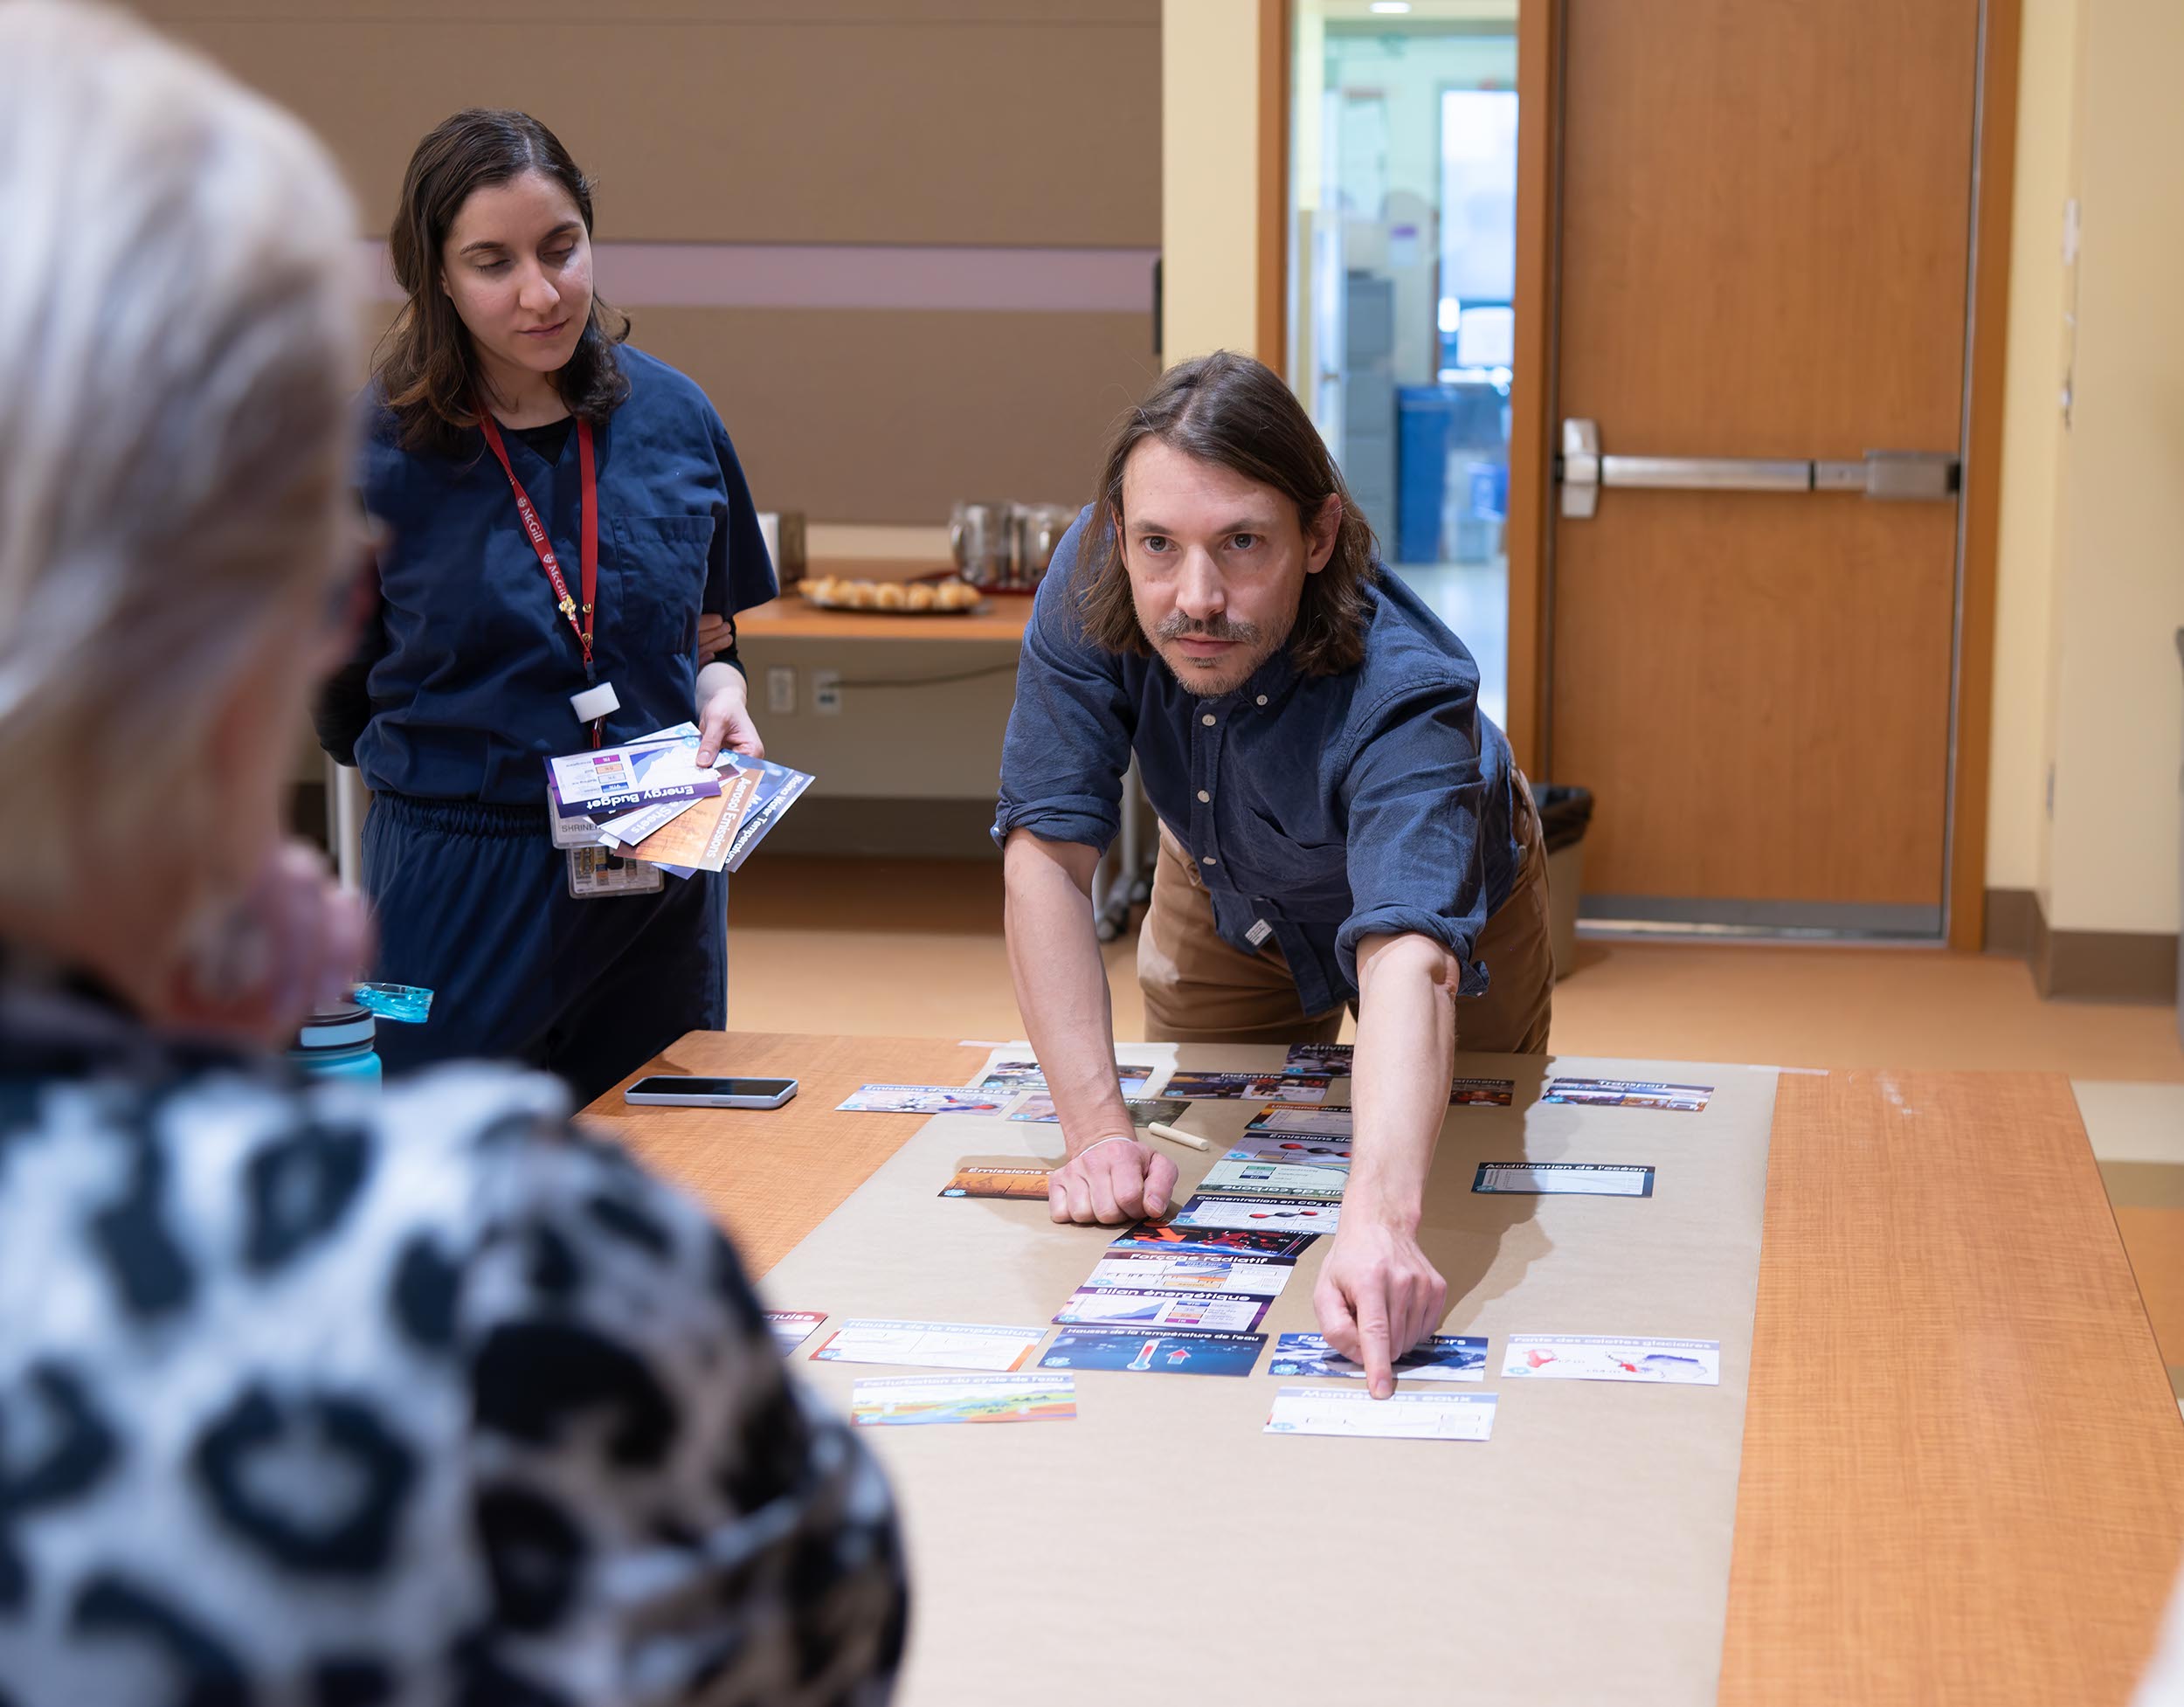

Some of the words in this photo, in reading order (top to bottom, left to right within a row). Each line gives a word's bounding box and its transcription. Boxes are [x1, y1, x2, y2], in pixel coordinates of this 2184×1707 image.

[522, 508, 545, 543] McGill
[549, 564, 568, 600] McGill
[586, 793, 640, 810] Budget
[643, 785, 695, 799] Energy
[726, 777, 752, 812] Aerosol
[762, 795, 786, 818] Water
[631, 806, 672, 834] Sheets
[706, 812, 737, 859] Emissions
[724, 817, 768, 864] Temperature
[1600, 1080, 1668, 1088] Transport
[1268, 1132, 1332, 1141] Émissions
[1130, 1254, 1199, 1262] Forçage
[1144, 1289, 1251, 1302] énergétique
